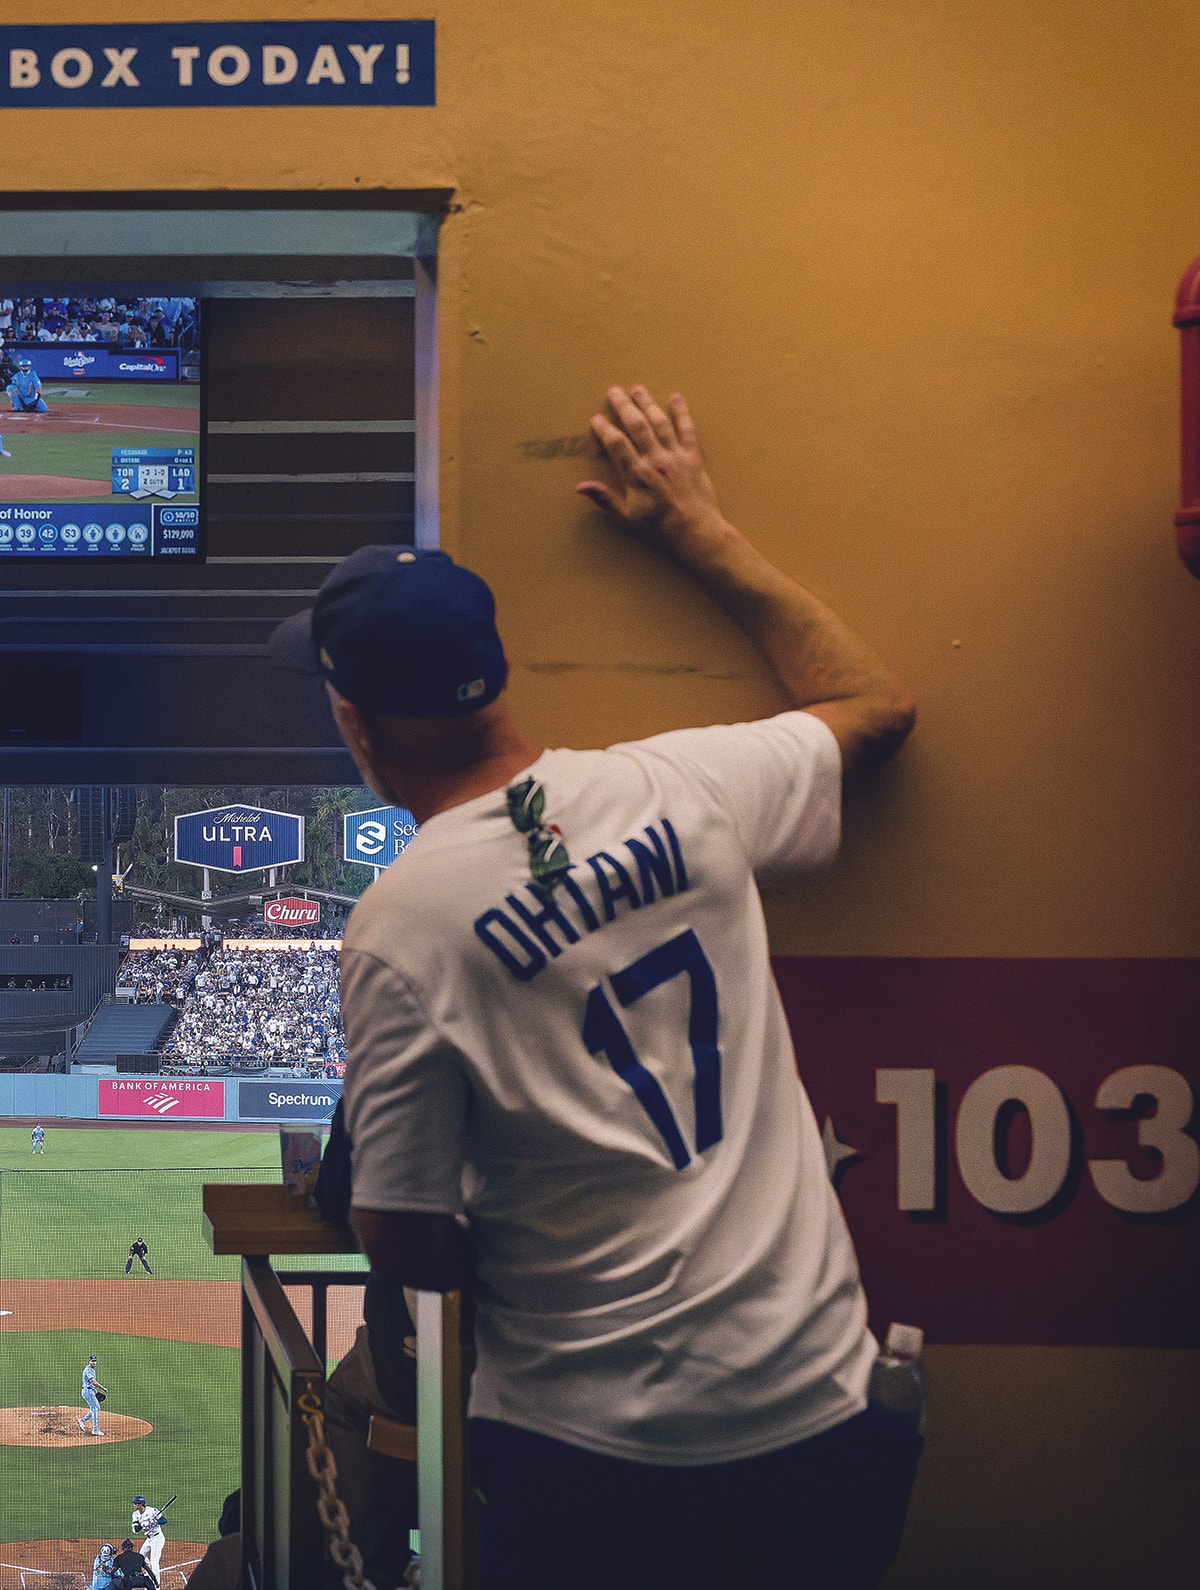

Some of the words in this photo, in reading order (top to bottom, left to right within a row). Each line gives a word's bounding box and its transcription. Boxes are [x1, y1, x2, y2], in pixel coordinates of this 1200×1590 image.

[9, 47, 140, 88] BOX
[172, 43, 411, 86] TODAY!
[116, 468, 134, 476] TOR
[172, 468, 190, 476] LAD
[121, 478, 130, 490] 2
[177, 478, 185, 490] 1
[0, 508, 12, 519] of
[14, 508, 53, 519] Honor
[19, 529, 33, 538] 39
[41, 529, 54, 538] 42
[65, 529, 77, 538] 53
[213, 812, 261, 824] Michelob
[202, 826, 273, 842] ULTRA
[474, 817, 689, 984] OHTANI
[266, 904, 315, 921] Churu
[582, 928, 723, 1171] 17
[111, 1081, 142, 1091] BANK
[144, 1082, 159, 1091] OF
[161, 1083, 211, 1092] AMERICA
[268, 1092, 332, 1108] Spectrum
[875, 1063, 1199, 1214] 103
